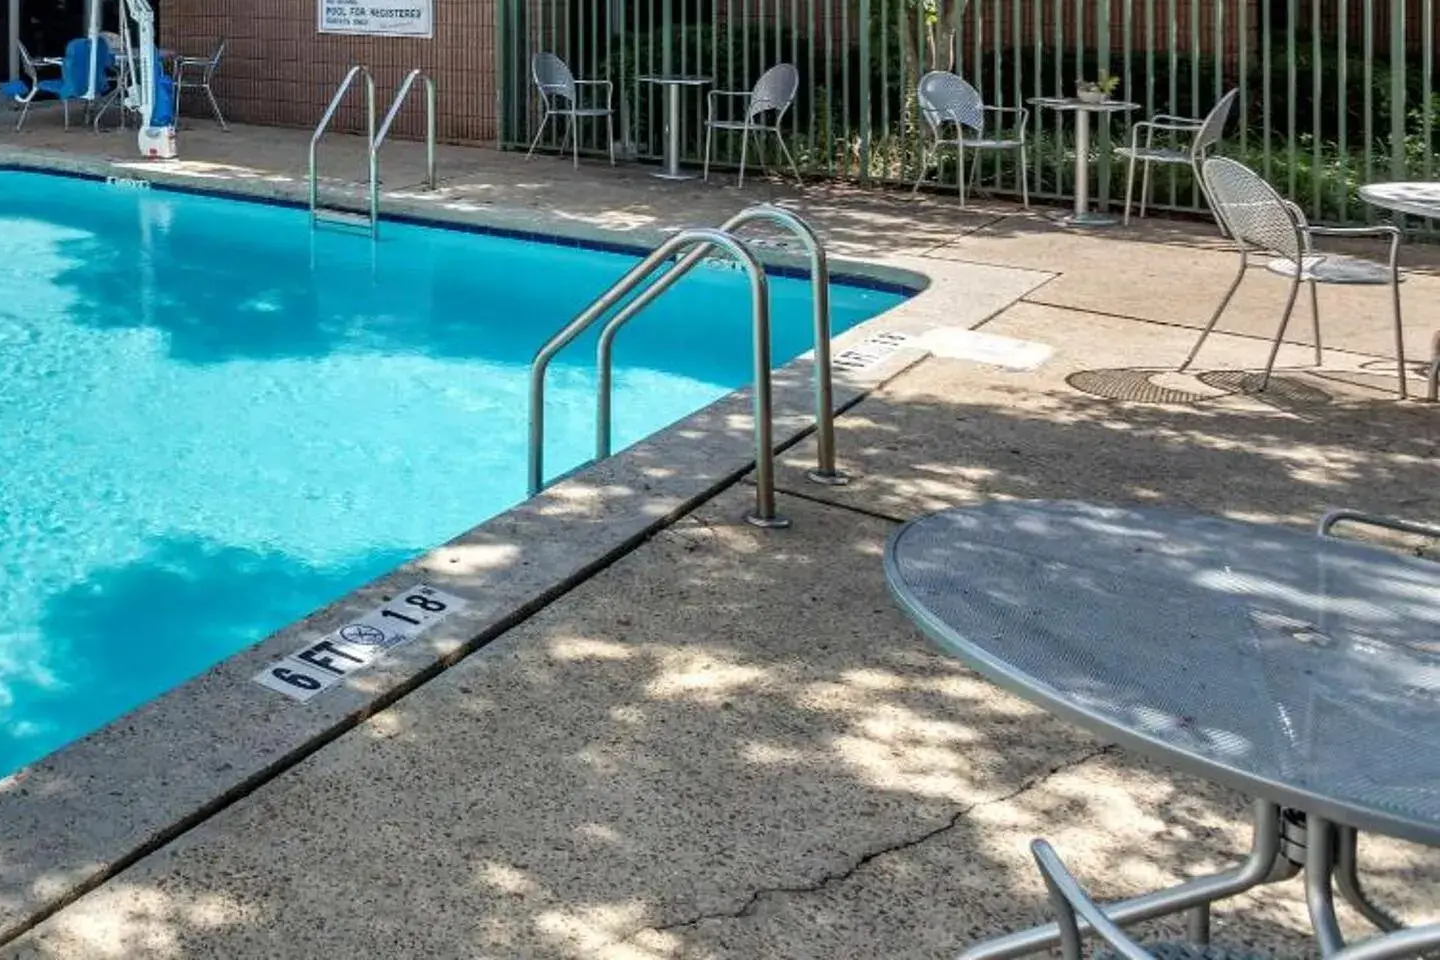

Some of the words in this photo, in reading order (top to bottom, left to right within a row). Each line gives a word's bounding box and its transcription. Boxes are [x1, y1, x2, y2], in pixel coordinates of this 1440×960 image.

[326, 7, 347, 16] POOL
[350, 7, 366, 17] FOR
[369, 8, 421, 18] REGISTERED
[271, 666, 322, 690] 6
[298, 640, 364, 675] FT
